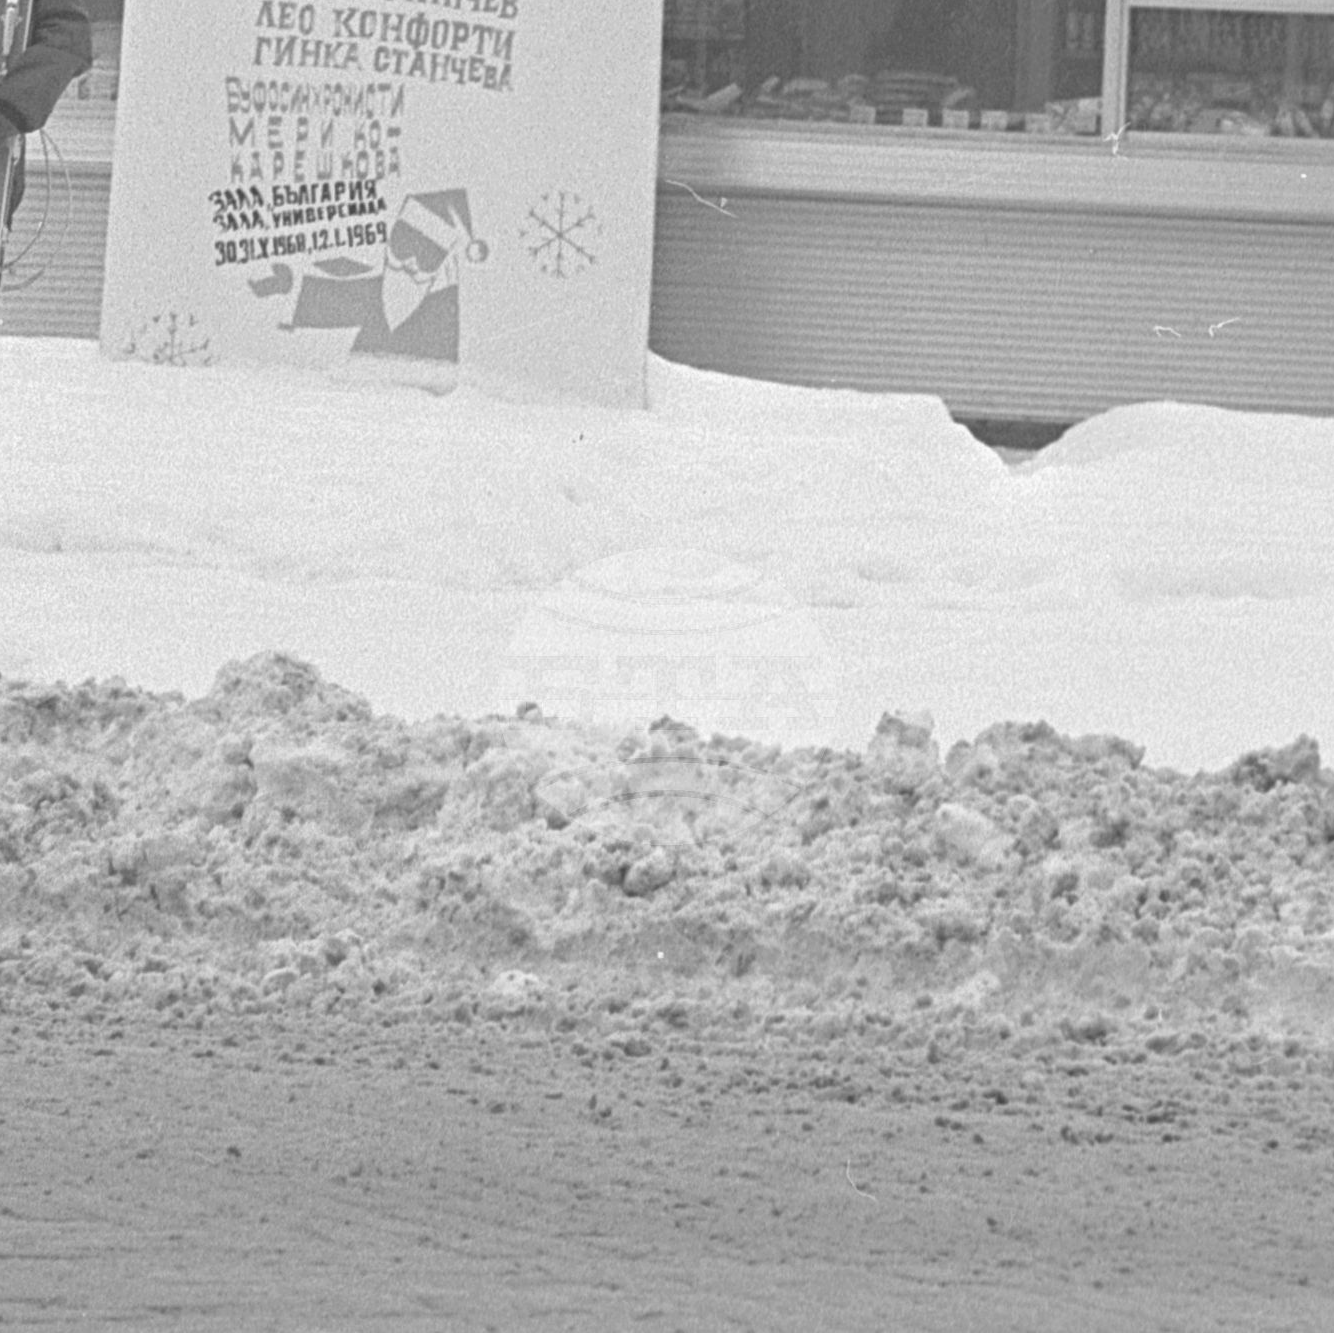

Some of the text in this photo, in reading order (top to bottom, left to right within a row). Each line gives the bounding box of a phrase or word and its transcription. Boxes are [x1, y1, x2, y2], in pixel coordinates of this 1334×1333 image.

[255, 0, 516, 62] ЛЕО КОНФОРТИ
[252, 35, 515, 92] ГИНКА СТАНЧЕВА
[229, 116, 334, 150] МЕРИ
[208, 185, 265, 213] ЗАЛА
